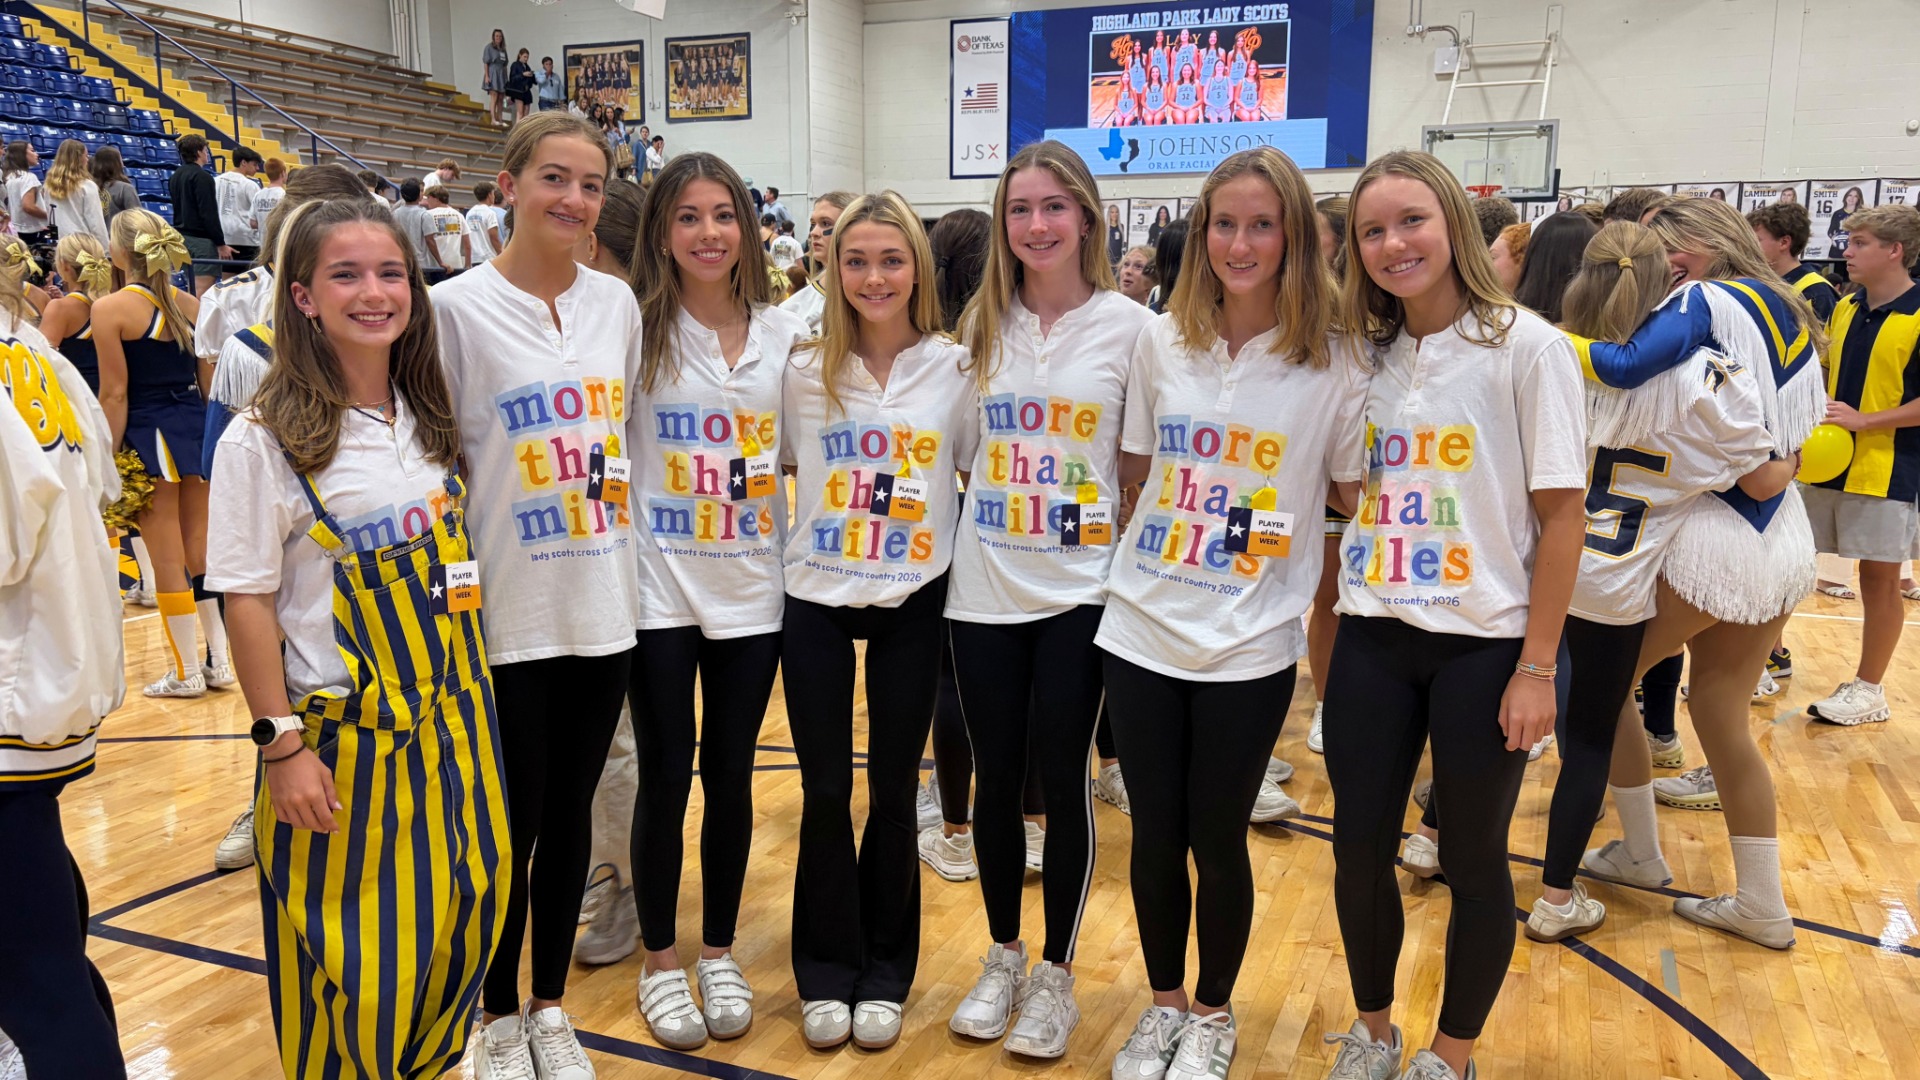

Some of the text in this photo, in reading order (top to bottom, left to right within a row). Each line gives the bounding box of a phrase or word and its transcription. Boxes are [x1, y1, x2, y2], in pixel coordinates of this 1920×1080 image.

[1092, 3, 1289, 31] HIGHLAND PARK LADY SCOTS
[971, 35, 991, 43] BANK
[982, 41, 1004, 50] TEXAS
[1166, 33, 1202, 46] LY
[961, 143, 999, 160] JSX
[1148, 161, 1175, 170] ORAL
[1752, 199, 1766, 210] 14
[1816, 200, 1833, 213] 16
[1888, 196, 1905, 204] 17
[1137, 213, 1145, 225] 3
[500, 382, 623, 431] more
[985, 401, 1097, 438] more
[657, 411, 775, 445] more
[822, 429, 937, 464] more
[1159, 423, 1280, 471] more
[519, 436, 603, 486] th
[751, 463, 770, 471] PLAYER
[990, 443, 1087, 487] than
[609, 466, 625, 475] PLAYER
[667, 454, 732, 496] th
[826, 470, 872, 509] th
[898, 486, 921, 495] PLAYER
[1158, 467, 1252, 518] ha
[898, 502, 915, 511] WEEK
[346, 493, 450, 551] mor
[652, 503, 774, 540] miles
[975, 495, 1062, 535] mile
[1258, 519, 1285, 529] PLAYER
[1269, 529, 1280, 537] the
[979, 536, 990, 546] ady
[992, 541, 1011, 550] scots
[1034, 545, 1063, 554] country
[1136, 522, 1260, 575] miles
[1259, 537, 1280, 546] WEEK
[531, 552, 549, 562] lady
[552, 548, 574, 558] scots
[577, 548, 600, 557] cross
[659, 546, 772, 560] ady scots cross country 2026
[452, 572, 473, 581] PLAYER
[805, 559, 922, 582] lady scots cross country 2026
[1136, 561, 1147, 574] lady
[1160, 571, 1182, 582] cross
[1184, 577, 1216, 592] country
[1218, 583, 1244, 597] 2026
[1347, 577, 1362, 587] lady
[455, 591, 472, 599] WEEK
[1379, 596, 1460, 607] oss country 2026
